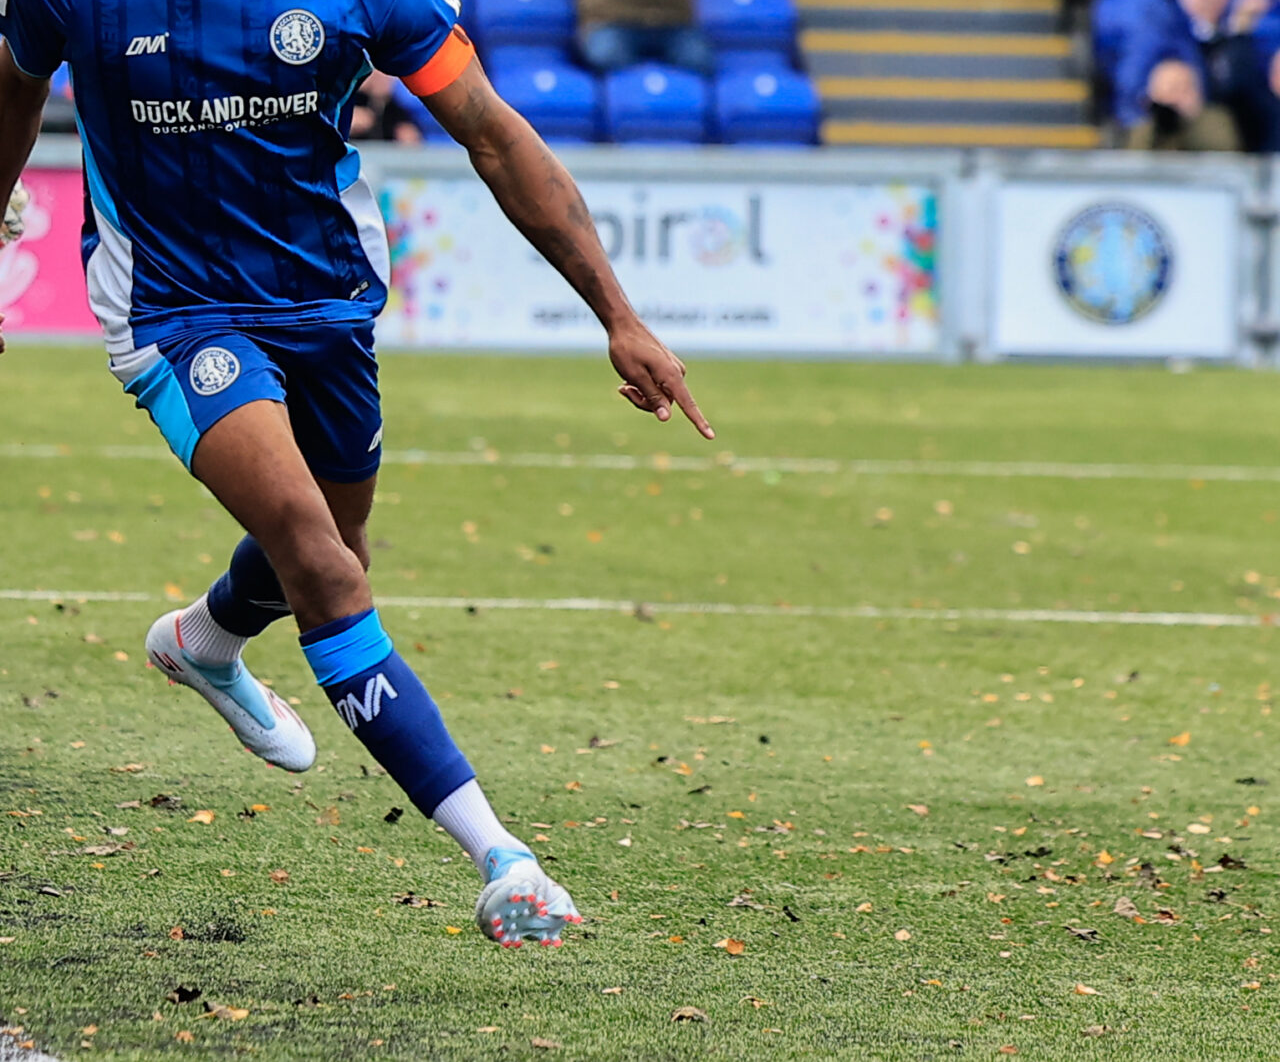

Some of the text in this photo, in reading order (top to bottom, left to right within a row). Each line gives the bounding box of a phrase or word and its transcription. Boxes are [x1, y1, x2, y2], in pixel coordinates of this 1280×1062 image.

[125, 34, 167, 56] DNA
[200, 95, 245, 124] AND
[249, 90, 319, 119] COVER
